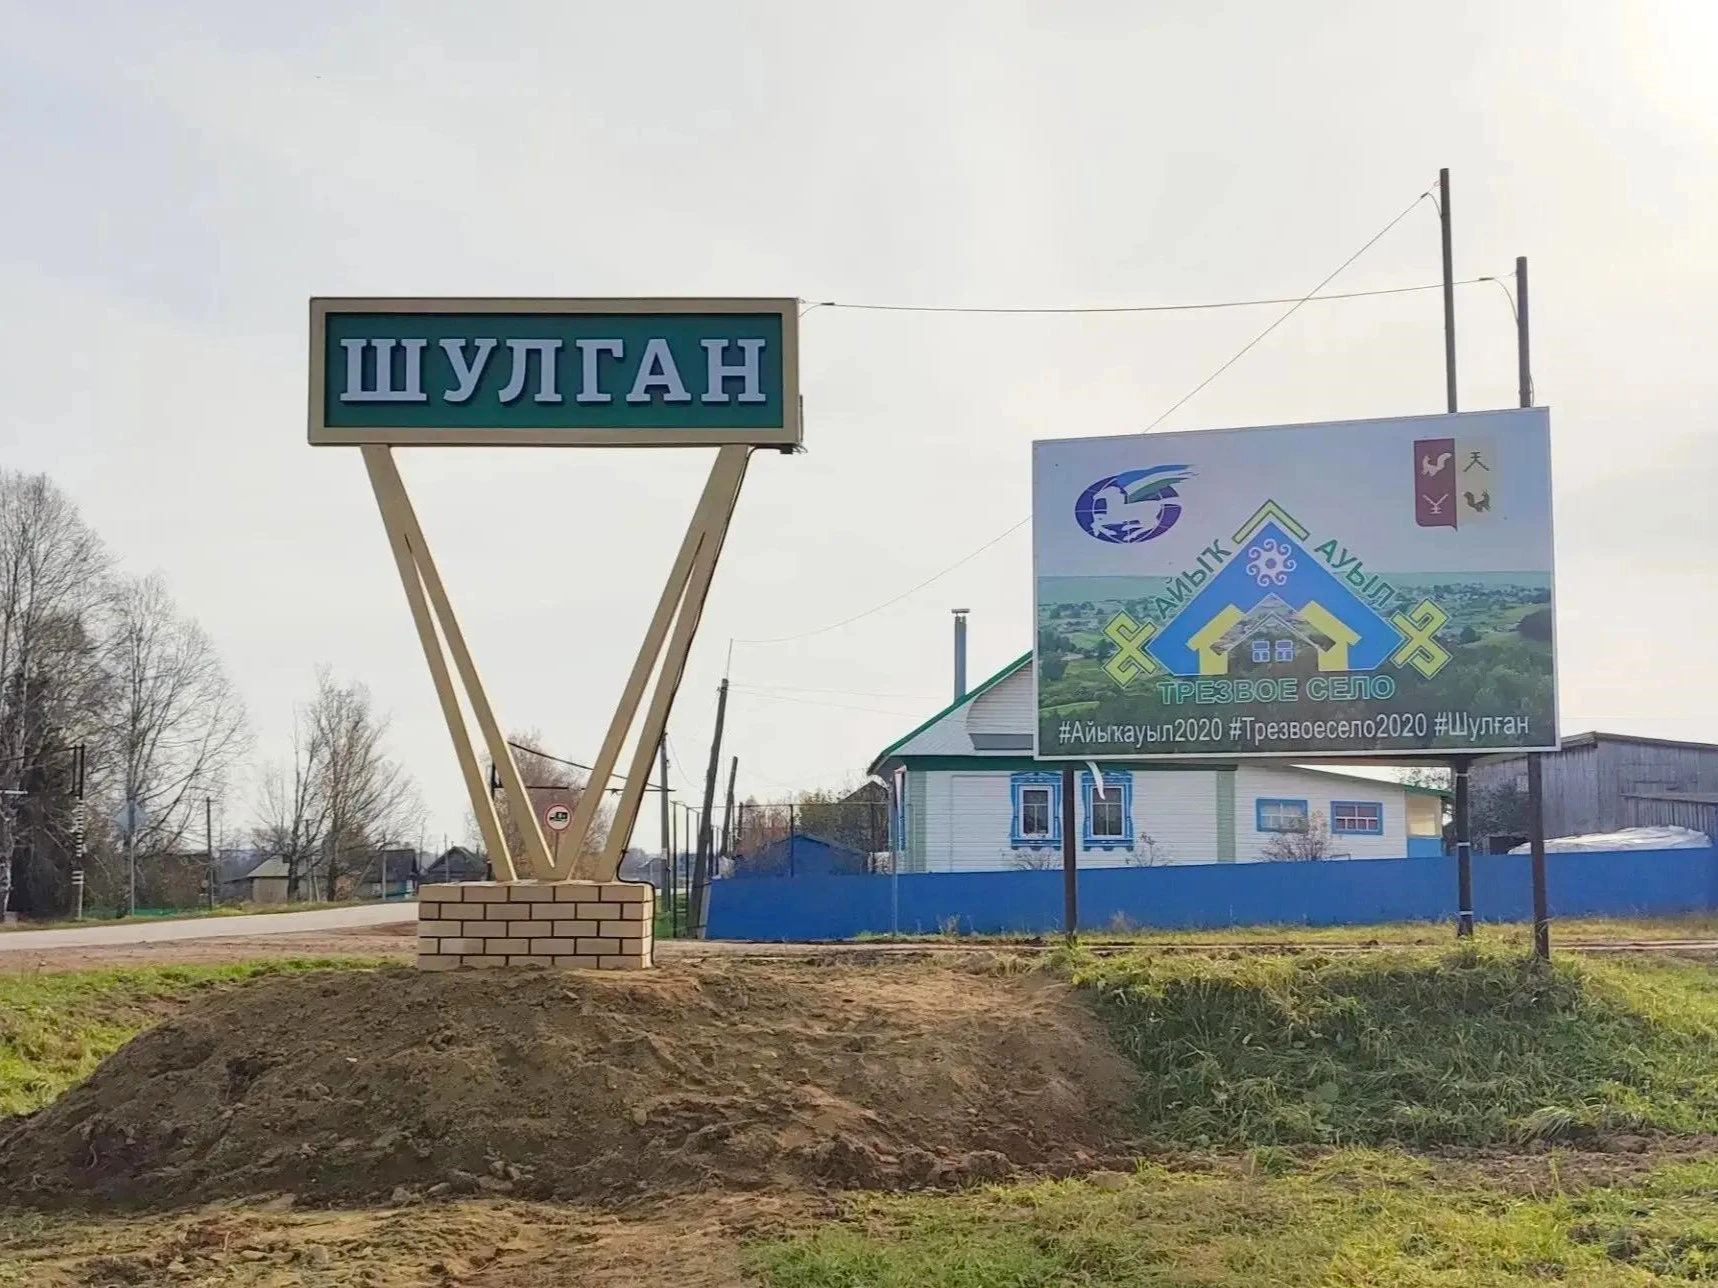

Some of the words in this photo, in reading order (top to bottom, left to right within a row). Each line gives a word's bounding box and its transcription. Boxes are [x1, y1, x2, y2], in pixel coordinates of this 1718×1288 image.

[339, 338, 766, 402] ШУЛГАН
[1314, 538, 1398, 608] АУЫЛ
[1157, 678, 1299, 705] ТРЕЗВОЕ
[1305, 674, 1396, 701] СЕЛО
[1229, 713, 1427, 746] #Трезвоесело2020
[1434, 712, 1529, 742] #Шулған
